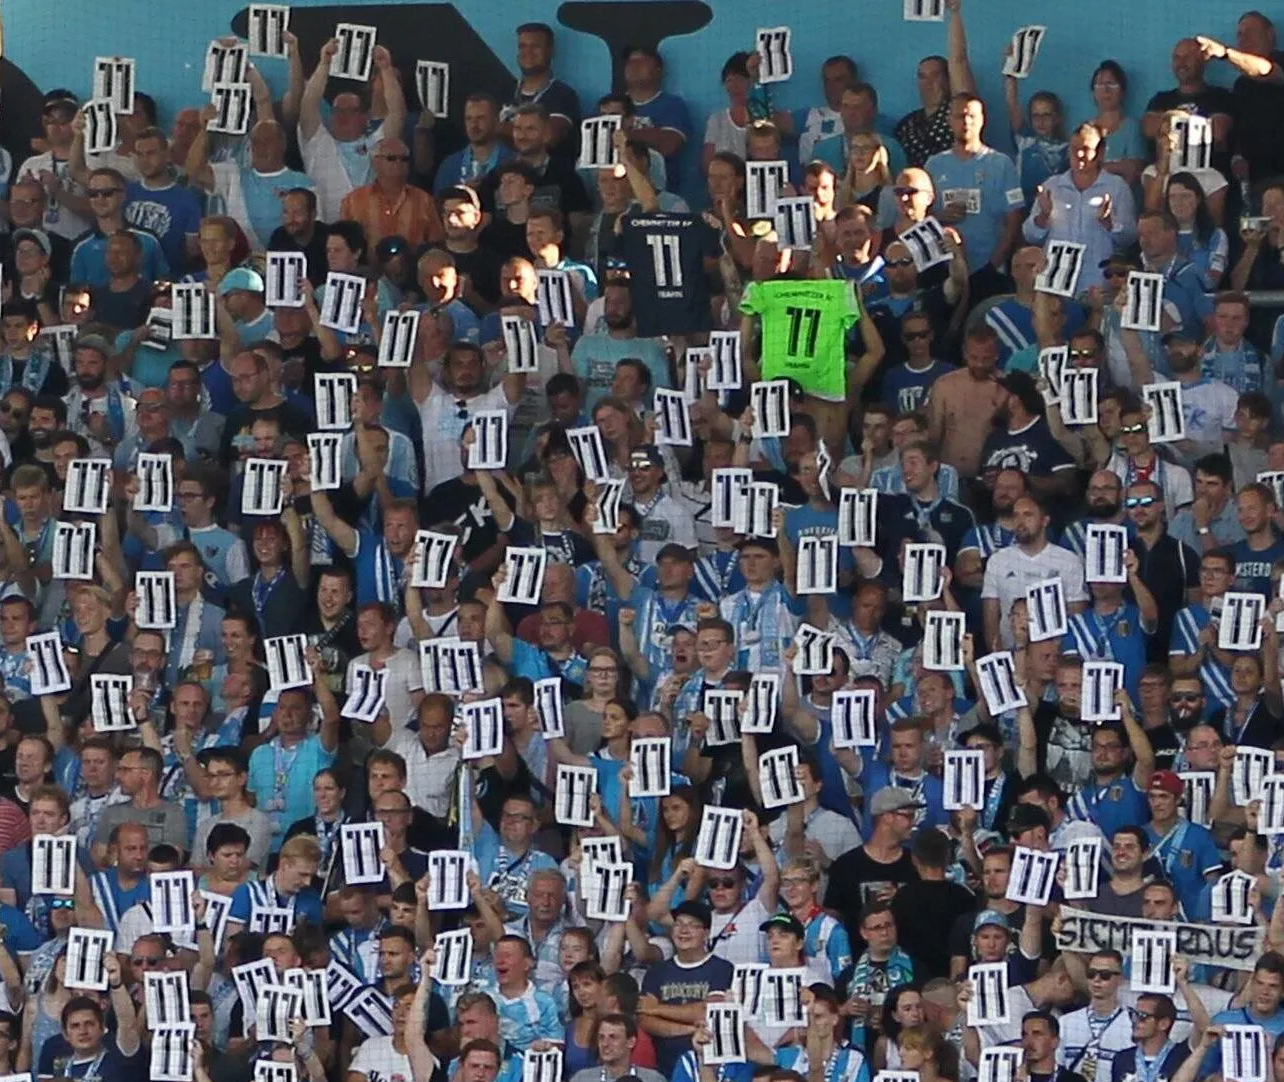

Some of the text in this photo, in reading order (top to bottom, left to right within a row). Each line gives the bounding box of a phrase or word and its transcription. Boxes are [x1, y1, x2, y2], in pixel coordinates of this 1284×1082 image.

[253, 9, 285, 54] 11
[585, 120, 621, 165] 11
[645, 233, 684, 287] 11
[1046, 245, 1081, 291] 11
[1129, 277, 1159, 326] 11
[388, 316, 414, 362] 11
[786, 306, 822, 358] 11
[711, 337, 737, 383] 11
[1147, 388, 1182, 436] 11
[311, 438, 338, 484] 11
[475, 416, 503, 463] 11
[141, 460, 169, 506] 11
[844, 493, 873, 542] 11
[803, 540, 833, 588] 11
[1091, 530, 1125, 576] 11
[139, 577, 172, 624] 11
[929, 616, 961, 665] 11
[1087, 668, 1123, 714] 11
[467, 705, 498, 752] 11
[837, 696, 871, 741] 11
[634, 743, 666, 792] 11
[948, 756, 979, 804] 11
[38, 840, 71, 889] 11
[432, 856, 465, 903] 11
[155, 877, 190, 926] 11
[74, 935, 107, 983] 11
[1137, 938, 1174, 986] 11
[149, 976, 185, 1023] 11
[158, 1028, 189, 1076] 11
